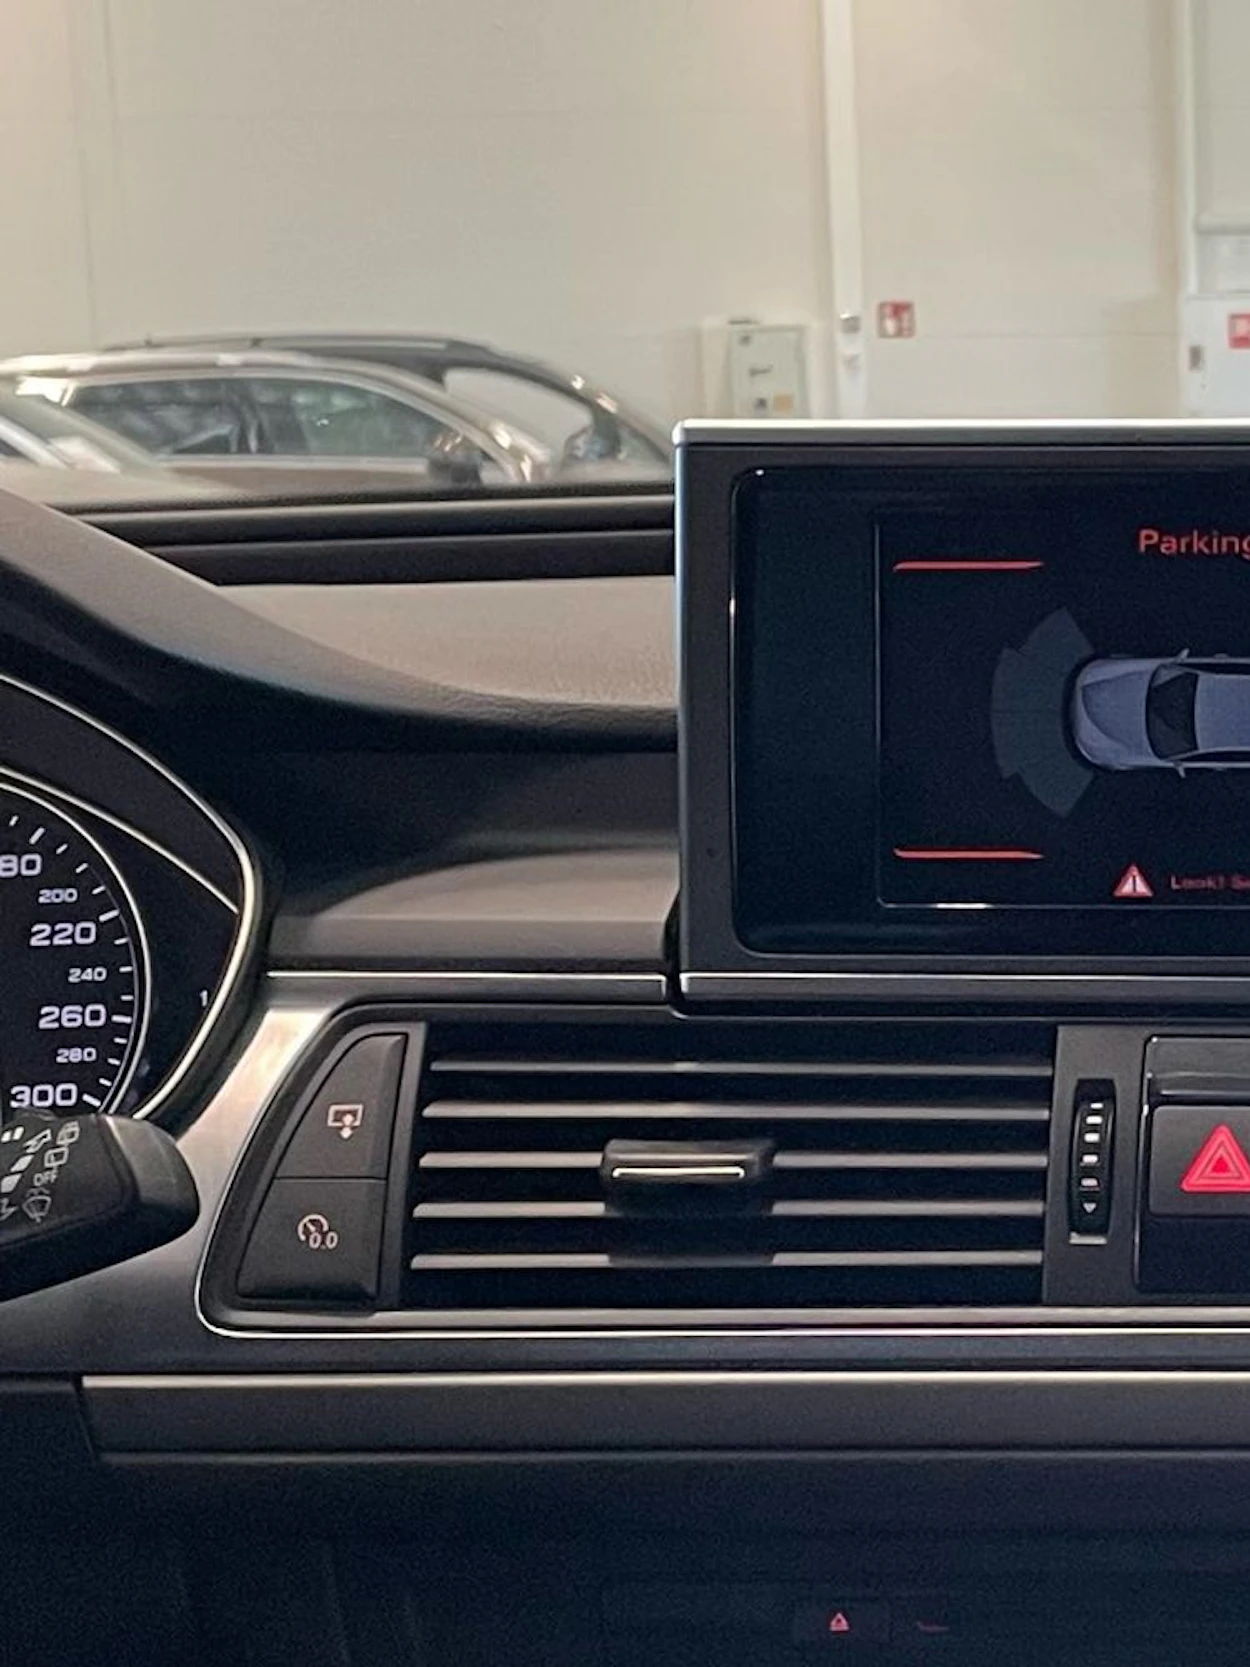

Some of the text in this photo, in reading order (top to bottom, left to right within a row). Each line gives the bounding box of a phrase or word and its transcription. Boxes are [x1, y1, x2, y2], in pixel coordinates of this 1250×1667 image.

[38, 888, 78, 904] 200
[29, 921, 97, 947] 220
[67, 966, 107, 983] 240
[38, 1003, 107, 1030] 260
[56, 1047, 97, 1064] 280
[10, 1082, 78, 1109] 300
